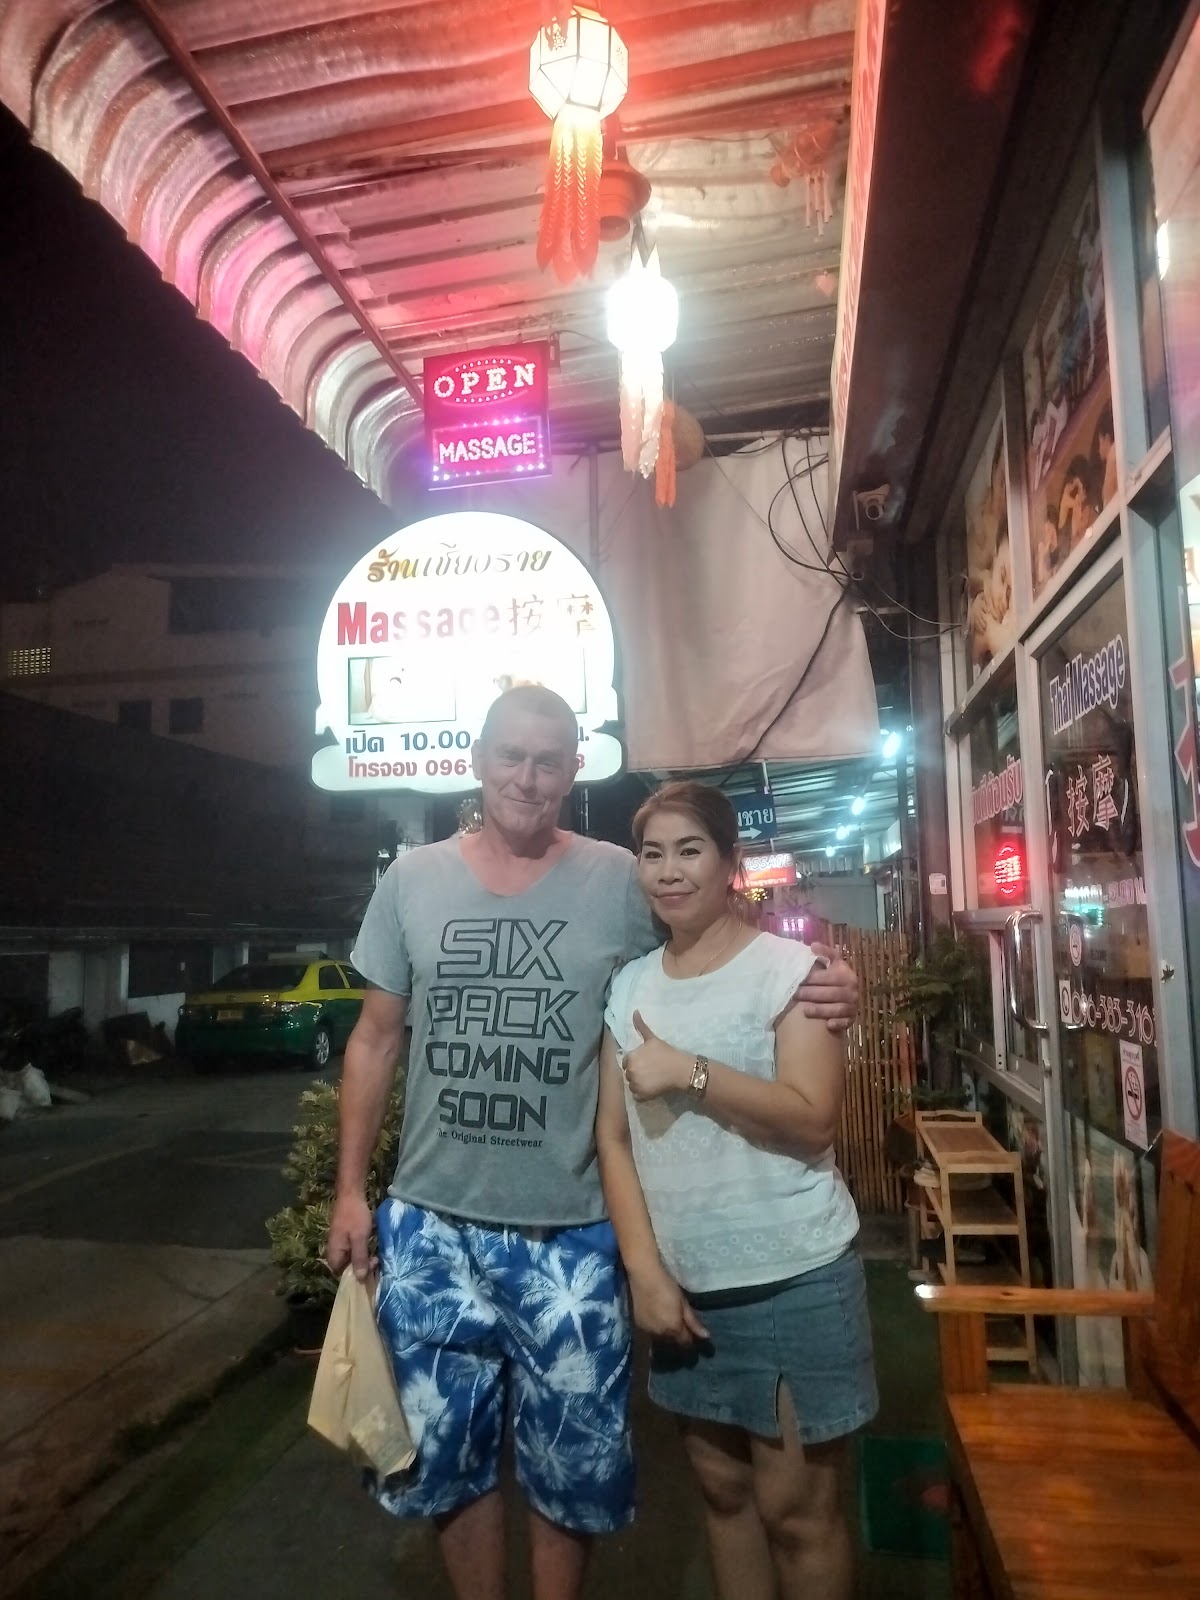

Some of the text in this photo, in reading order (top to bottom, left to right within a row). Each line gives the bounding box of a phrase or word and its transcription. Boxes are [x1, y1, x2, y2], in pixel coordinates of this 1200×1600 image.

[433, 362, 536, 398] OPEN
[439, 431, 536, 464] MASSAGE
[337, 601, 500, 645] Massage
[1049, 633, 1126, 736] Thai Massage
[345, 729, 471, 754] เปิด 10.00
[348, 755, 418, 778] โทรจอง
[1066, 754, 1119, 837] 按摩
[743, 853, 794, 872] ASSAGE
[437, 918, 568, 981] SIX
[427, 985, 580, 1042] PACK
[425, 1042, 571, 1085] COMING
[438, 1088, 547, 1132] SOON
[451, 1130, 486, 1145] Original
[490, 1135, 543, 1148] Streetwear
